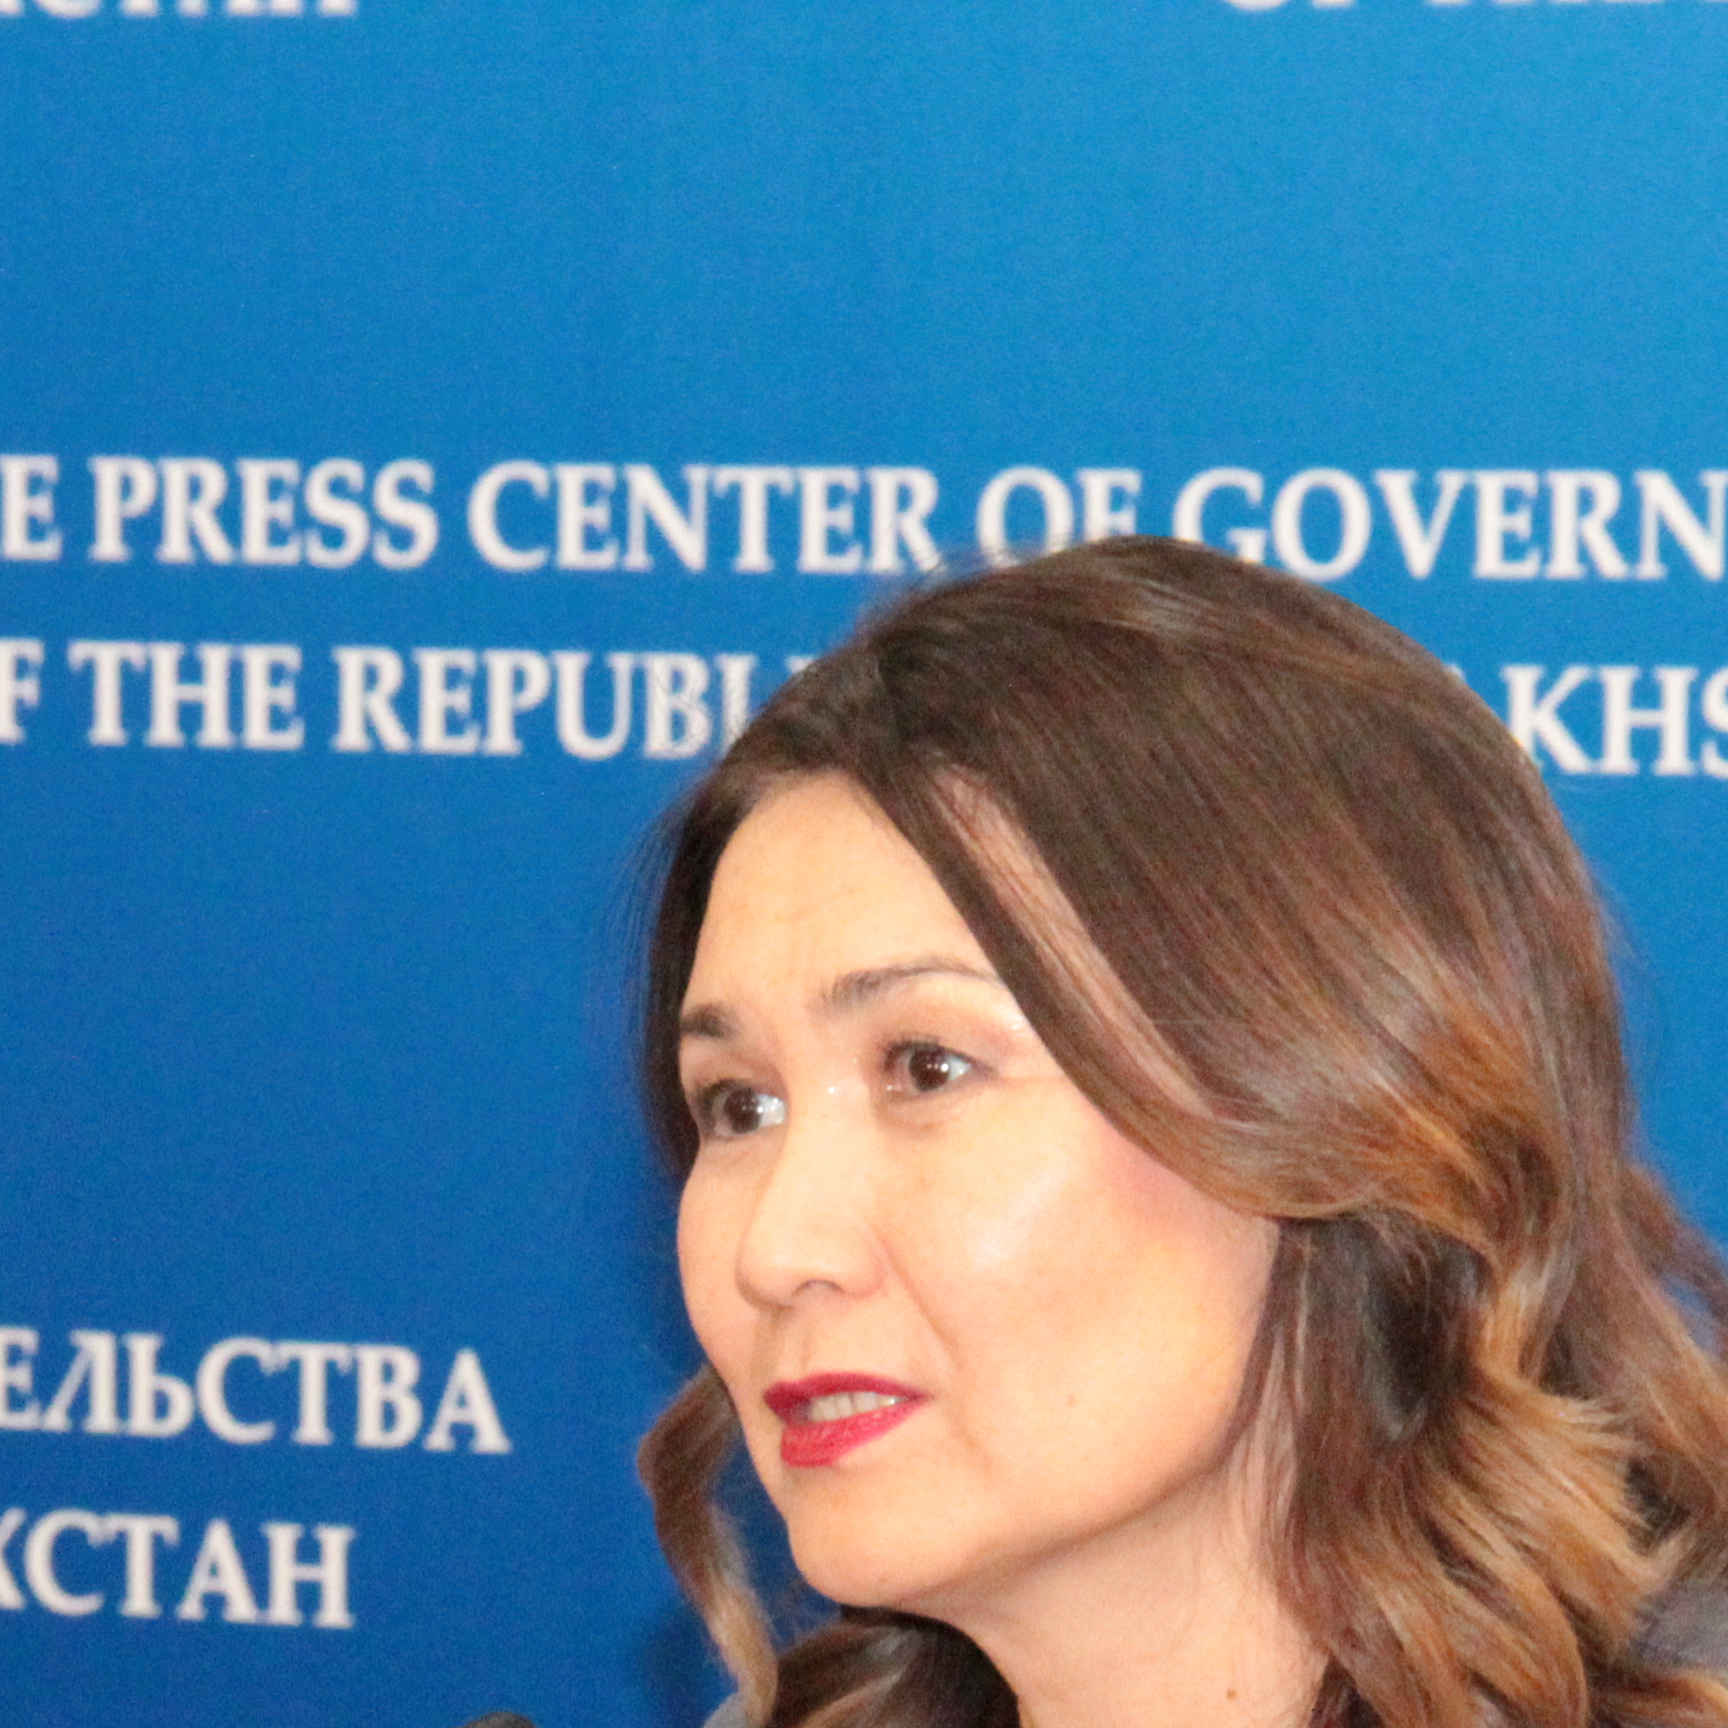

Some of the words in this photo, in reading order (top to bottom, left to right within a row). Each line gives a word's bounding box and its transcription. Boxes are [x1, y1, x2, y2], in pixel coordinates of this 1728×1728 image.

[90, 455, 440, 571] PRESS
[466, 461, 946, 575] CENTER
[975, 465, 1142, 569] OF
[67, 639, 305, 751] THE
[332, 644, 802, 760] REPUBL
